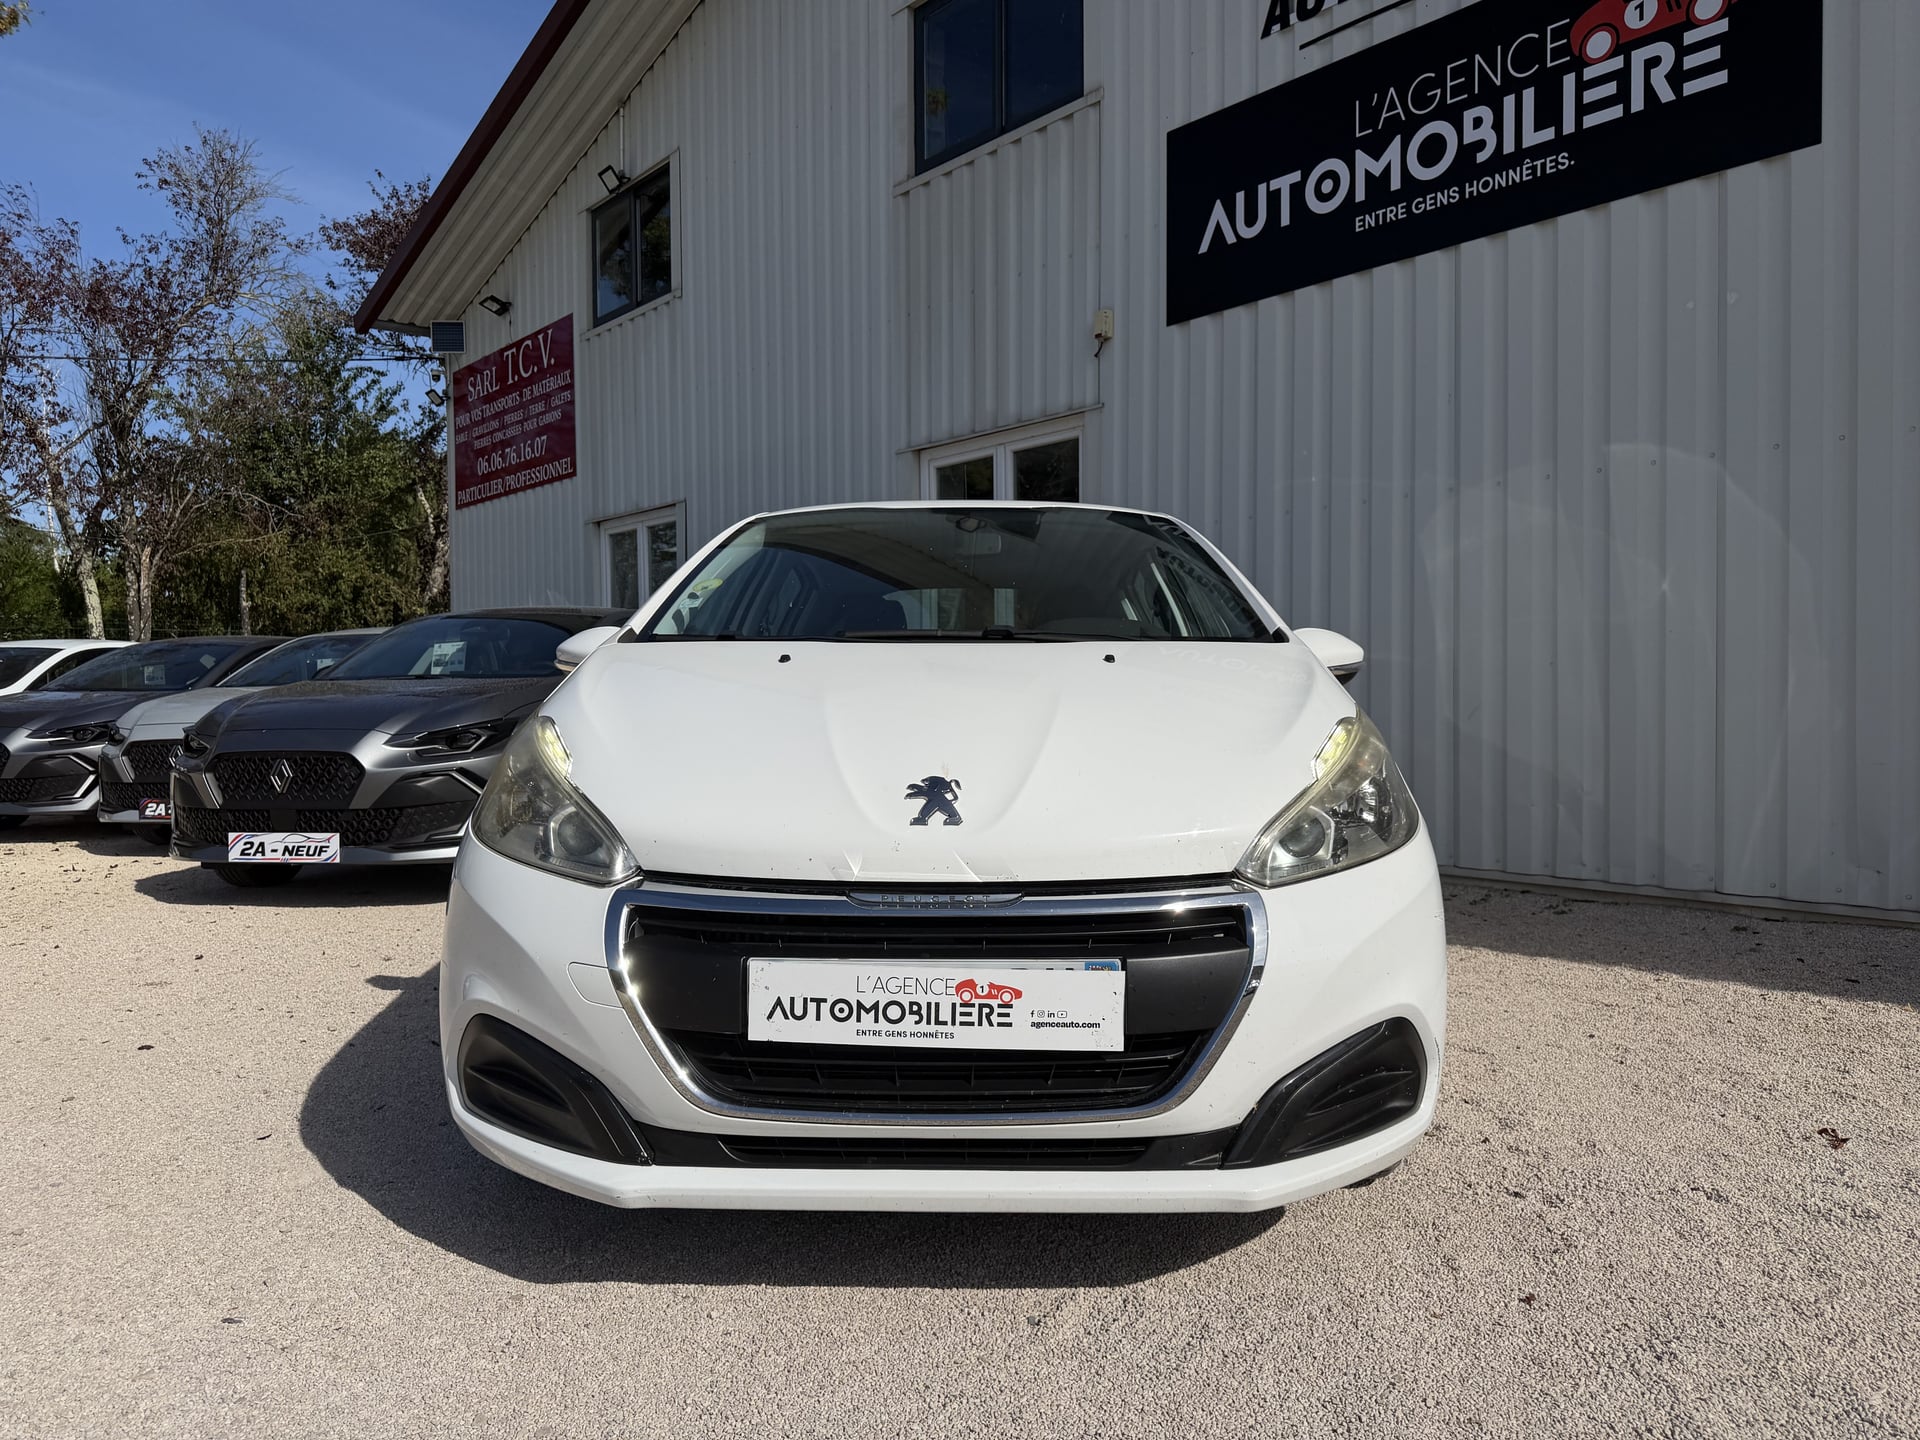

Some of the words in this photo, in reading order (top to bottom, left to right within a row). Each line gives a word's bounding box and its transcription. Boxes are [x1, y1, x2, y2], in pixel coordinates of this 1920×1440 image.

[1634, 1, 1645, 22] 1
[1355, 18, 1570, 135] L'AGENCE
[1355, 203, 1407, 232] ENTRE
[1411, 186, 1459, 214] GENS
[1465, 152, 1575, 199] HONNÊTES.
[467, 367, 501, 401] SARL
[504, 329, 556, 384] T.C.V.
[455, 412, 471, 429] POUR
[471, 408, 481, 421] VOS
[483, 392, 520, 418] TRANSPORTS
[522, 387, 533, 401] DE
[551, 391, 571, 407] GALETS
[477, 435, 548, 476] 06.06.76.16.07
[240, 841, 266, 857] 2A
[282, 845, 330, 857] NEUF
[856, 1029, 883, 1038] ENTRE
[885, 1030, 908, 1039] GENS
[909, 1029, 955, 1040] HONNÊTES
[1030, 1020, 1101, 1030] agenceauto.com
